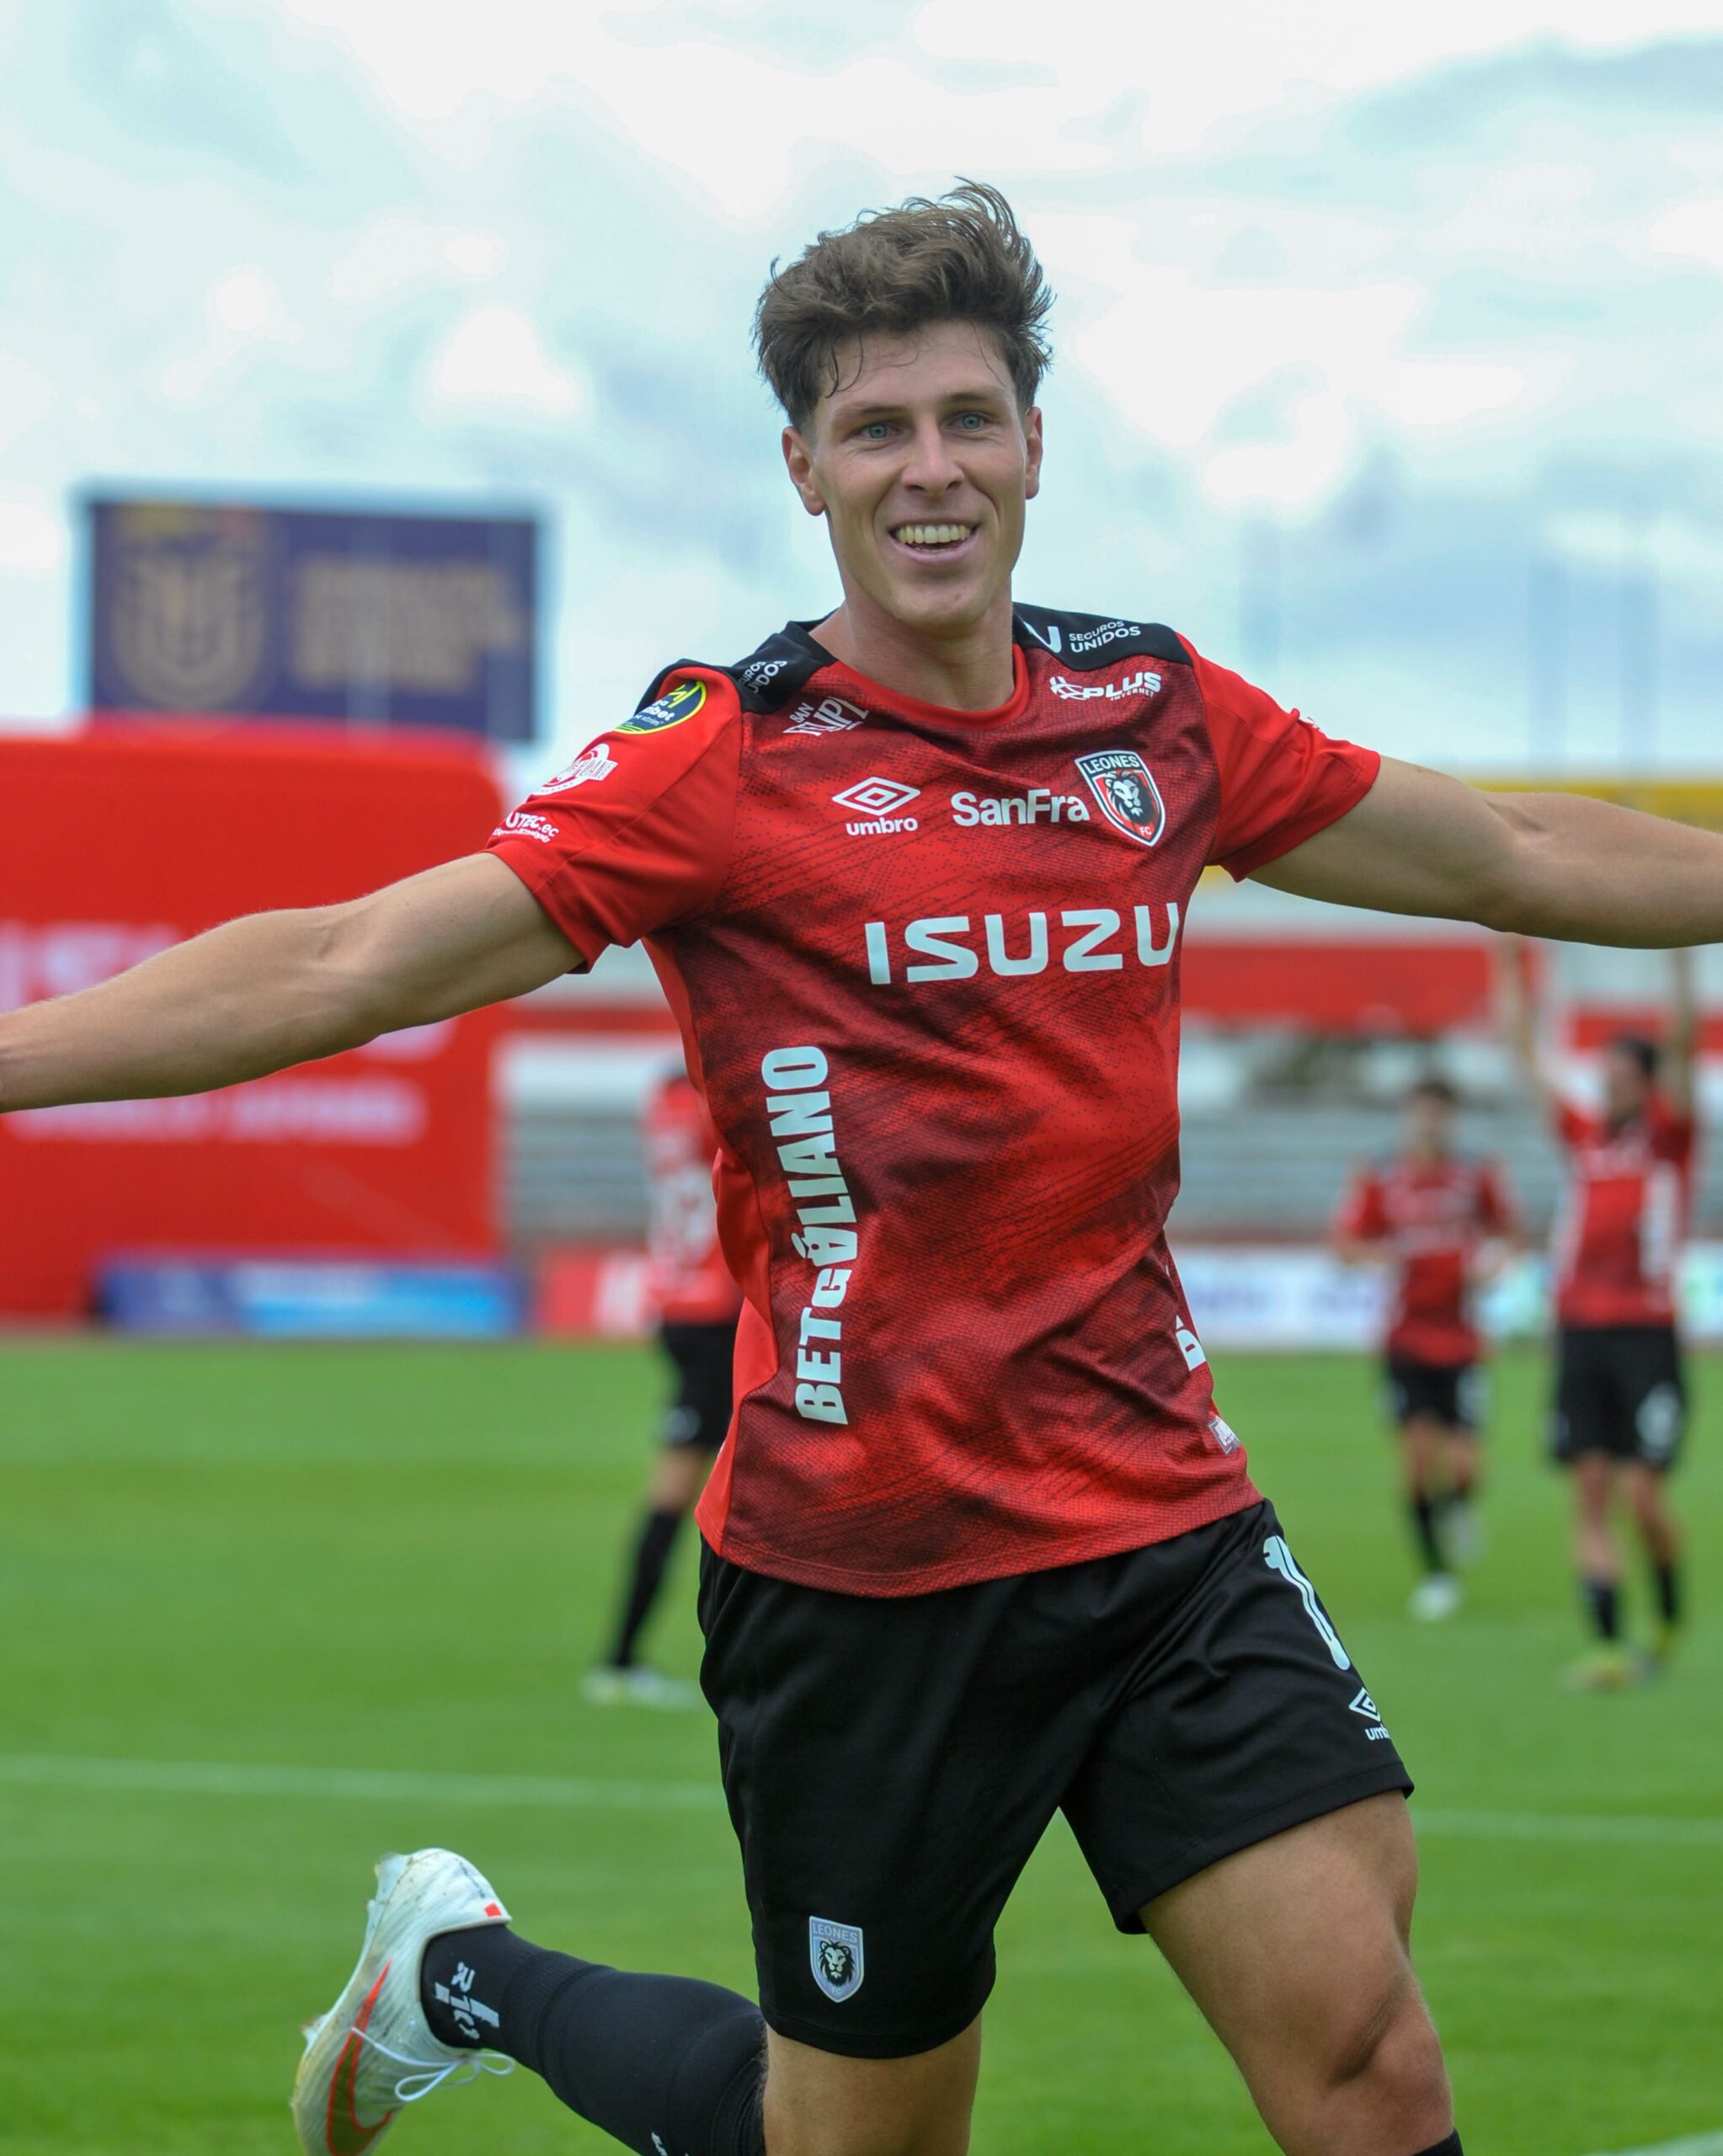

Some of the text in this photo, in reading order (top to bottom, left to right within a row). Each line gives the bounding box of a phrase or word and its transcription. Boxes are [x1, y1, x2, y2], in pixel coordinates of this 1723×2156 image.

[1069, 620, 1125, 642] SEGUROS
[1070, 626, 1142, 654] UNIDOS
[1111, 686, 1155, 702] INTERNET
[789, 702, 814, 723] SAN
[1083, 755, 1141, 775] LEONES
[951, 788, 1091, 827] SanFra
[845, 817, 919, 836] umbro
[1139, 826, 1152, 836] FC
[865, 902, 1180, 985] ISUZU
[813, 1922, 858, 1943] LEONES
